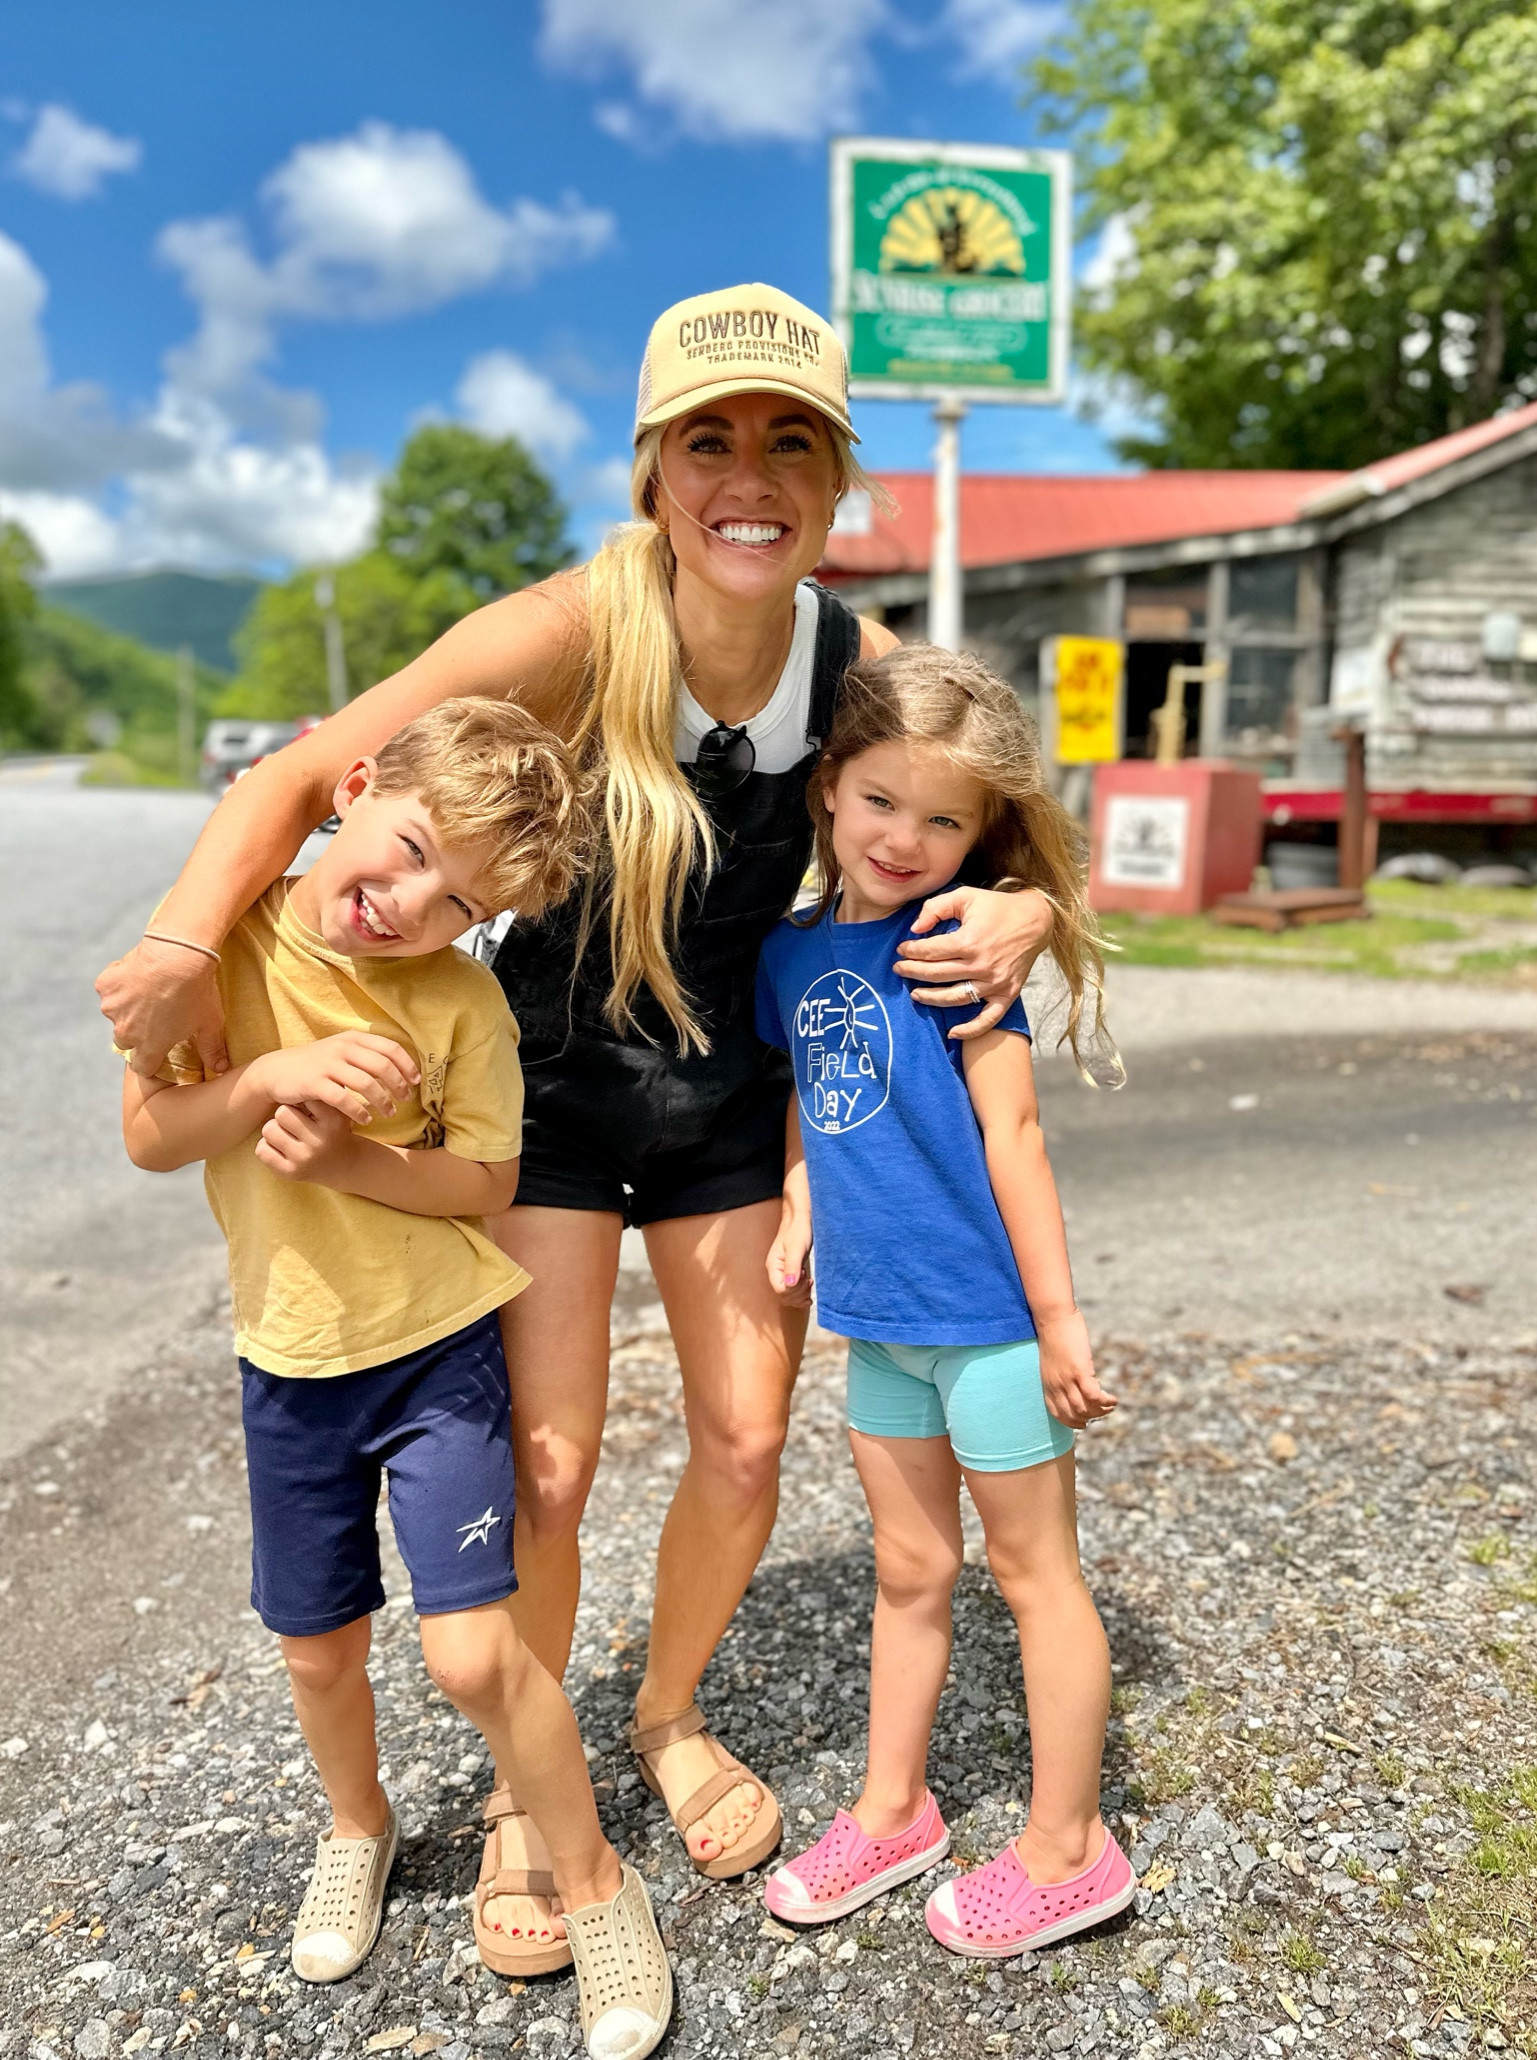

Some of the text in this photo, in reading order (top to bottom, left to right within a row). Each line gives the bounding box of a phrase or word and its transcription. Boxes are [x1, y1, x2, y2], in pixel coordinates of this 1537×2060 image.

[679, 310, 820, 355] COWBOY HAT
[707, 351, 774, 364] TRADEMARK
[738, 339, 800, 358] PROVISIONS
[797, 998, 831, 1038] CEE
[823, 1120, 841, 1131] 2022
